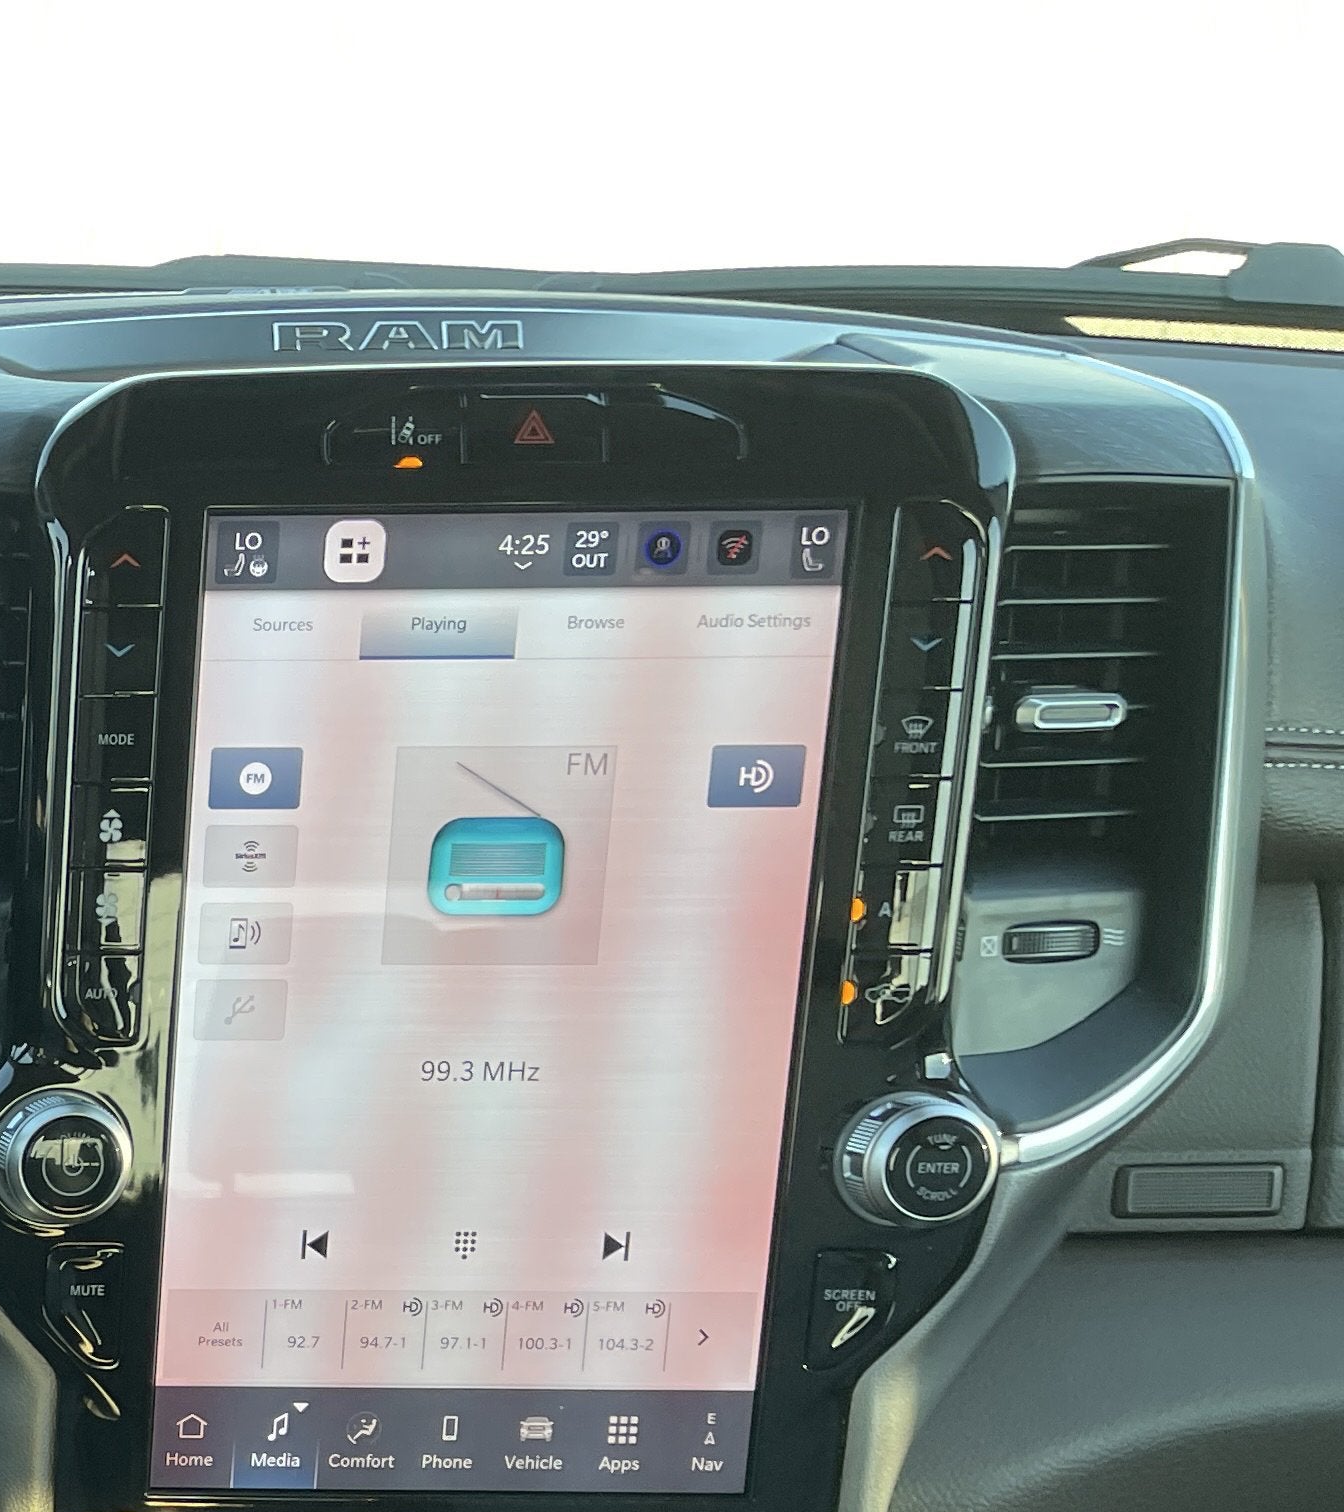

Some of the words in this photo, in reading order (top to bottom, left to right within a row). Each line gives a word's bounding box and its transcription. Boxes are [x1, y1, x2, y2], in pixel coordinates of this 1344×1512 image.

[272, 319, 525, 352] RAM
[416, 433, 443, 446] OFF
[234, 531, 262, 551] LO
[575, 530, 609, 549] 29°
[801, 526, 830, 546] LO
[498, 534, 550, 556] 4:25
[571, 553, 609, 569] OUT
[252, 616, 314, 633] Sources
[411, 615, 468, 634] Playing
[567, 614, 625, 631] Browse
[696, 612, 745, 629] Audio
[748, 612, 811, 632] Settings
[98, 733, 135, 746] MODE
[893, 740, 940, 755] FRONT
[566, 752, 609, 777] FM
[246, 773, 265, 785] FM
[888, 830, 924, 843] REAR
[84, 987, 119, 1000] AUTO
[420, 1060, 474, 1083] 99.3
[483, 1060, 541, 1083] MHz
[917, 1161, 960, 1175] ENTER
[915, 1185, 959, 1202] SCROLL
[69, 1284, 105, 1297] MUTE
[823, 1288, 877, 1301] SCREEN
[272, 1299, 303, 1310] 1-FM
[350, 1299, 383, 1311] 2-FM
[431, 1300, 463, 1311] 3-FM
[511, 1301, 544, 1312] 4-FM
[592, 1301, 625, 1312] 5-FM
[212, 1321, 230, 1333] All
[198, 1335, 243, 1347] Presets
[287, 1335, 320, 1349] 92.7
[359, 1336, 407, 1349] 94.7-1
[440, 1337, 487, 1350] 97.1-1
[518, 1337, 572, 1350] 100.3-1
[598, 1338, 654, 1351] 104.3-2
[165, 1452, 214, 1468] Home
[250, 1452, 301, 1468] Media
[328, 1453, 396, 1470] Comfort
[421, 1453, 473, 1470] Phone
[504, 1454, 563, 1471] Vehicle
[598, 1456, 640, 1474] Apps
[691, 1456, 724, 1473] Nav
